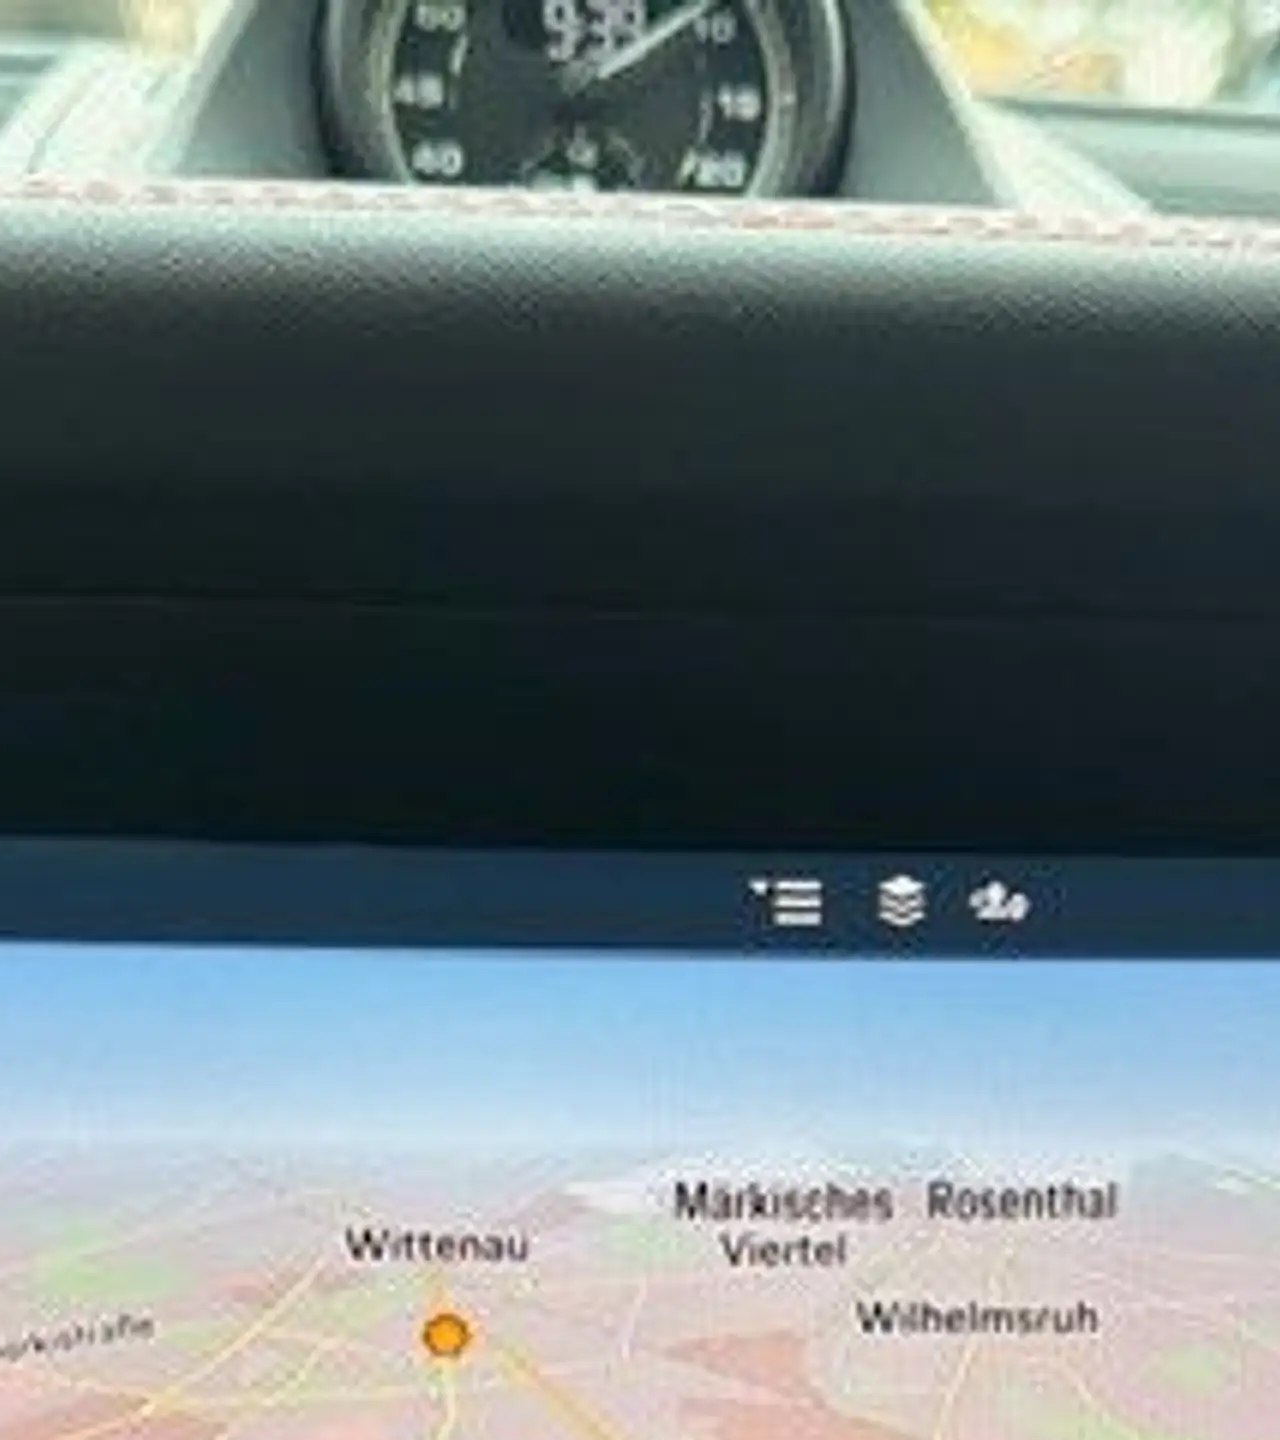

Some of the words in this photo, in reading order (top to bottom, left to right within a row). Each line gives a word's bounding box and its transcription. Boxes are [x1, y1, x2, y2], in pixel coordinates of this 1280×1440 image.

[674, 1179, 894, 1222] Märkisches
[927, 1182, 1118, 1220] Rosenthal
[345, 1228, 531, 1265] Wittenau
[720, 1233, 849, 1268] Viertel
[856, 1300, 1100, 1336] Wilhelmsruh
